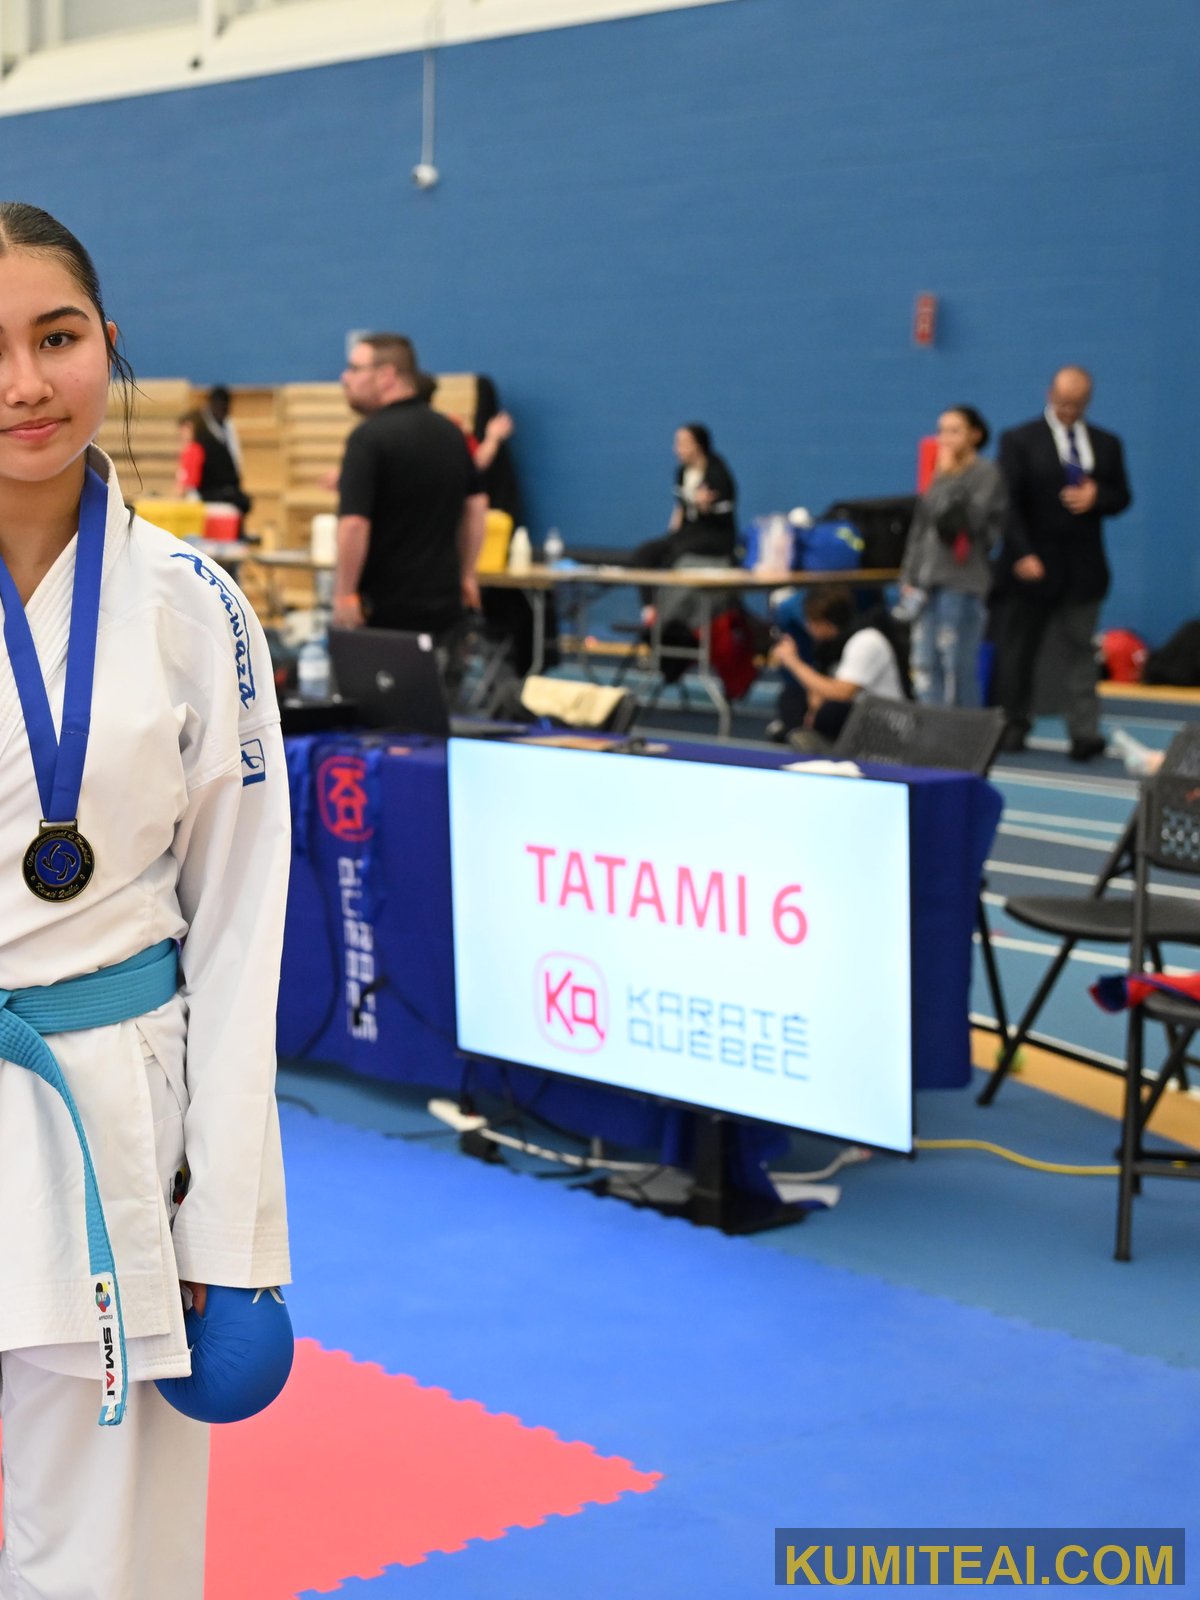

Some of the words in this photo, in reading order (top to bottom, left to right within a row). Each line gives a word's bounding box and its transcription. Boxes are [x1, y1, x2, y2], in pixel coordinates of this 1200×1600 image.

[525, 845, 747, 937] TATAMI
[772, 884, 808, 946] 6
[626, 984, 809, 1047] KARATÉ
[627, 1017, 810, 1082] QUÉBEC
